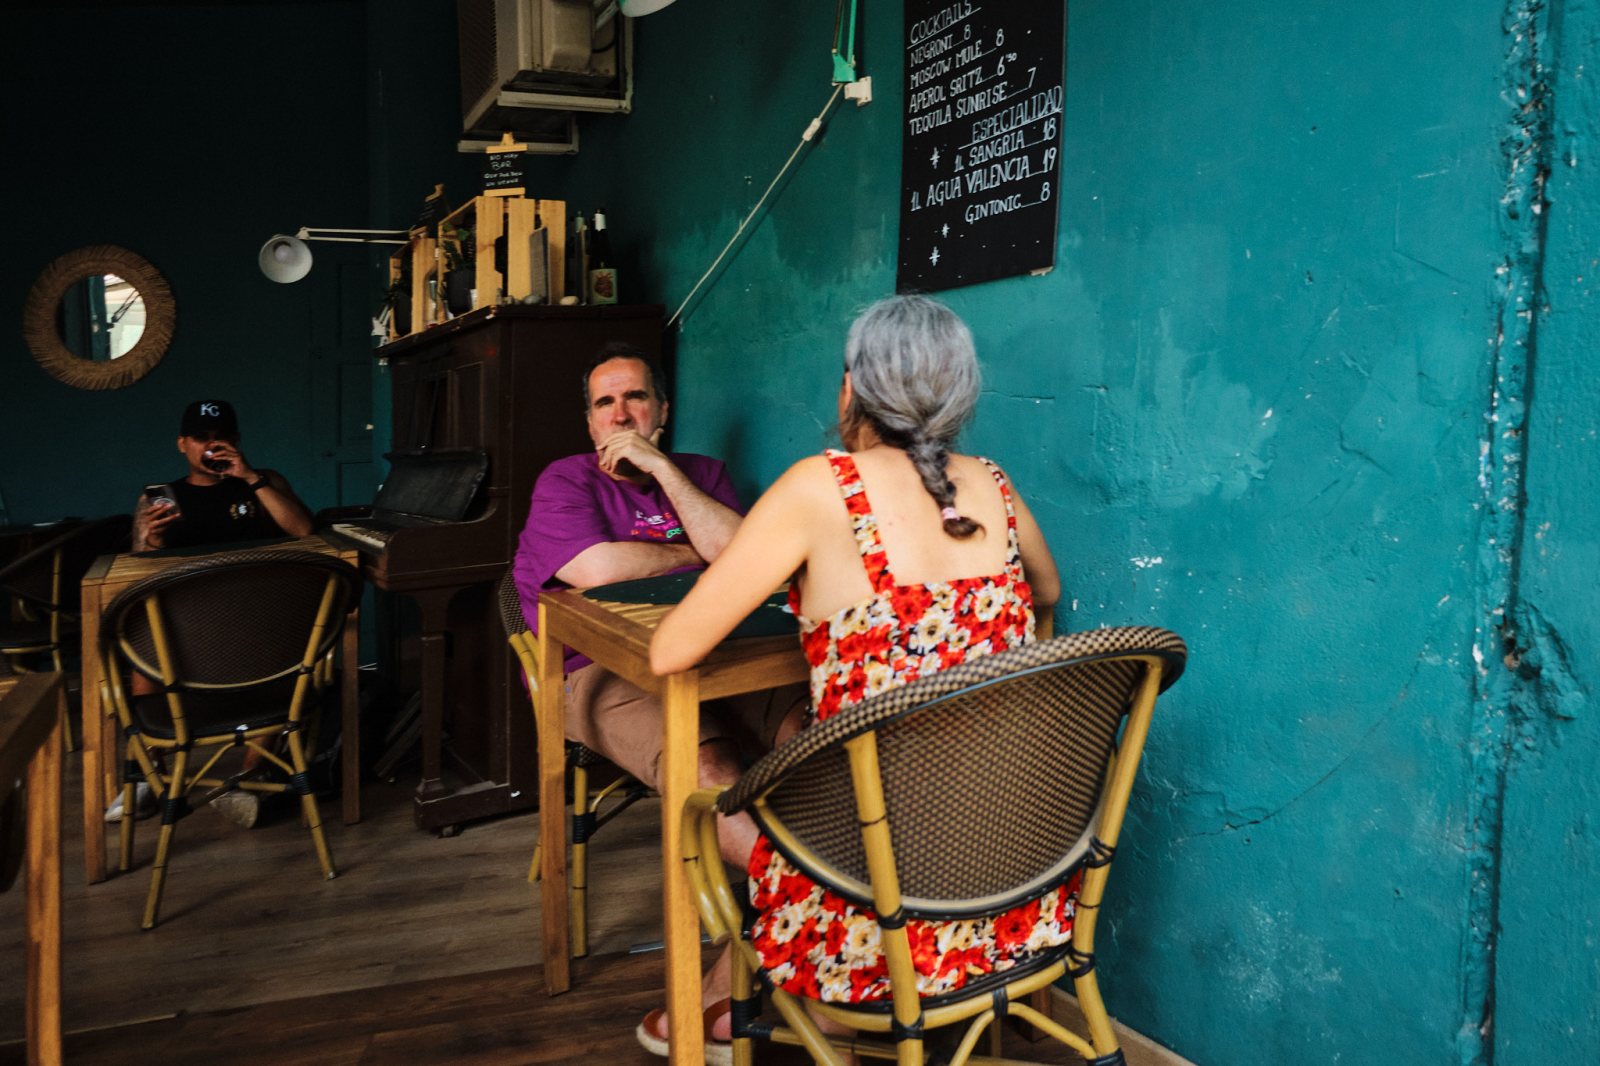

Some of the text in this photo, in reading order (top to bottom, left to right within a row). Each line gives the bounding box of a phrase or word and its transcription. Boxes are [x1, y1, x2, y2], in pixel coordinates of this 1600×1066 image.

[910, 0, 972, 44] COCKTAILS
[910, 24, 971, 67] NEGRONI 8
[910, 28, 1004, 90] MOSCOW MULE 8
[908, 86, 946, 114] APEROL
[909, 67, 1037, 136] TEQUILA SUNRISE 7
[972, 85, 1063, 144] ESPECIALIDAD
[969, 130, 1025, 166] SANGRIA
[1043, 117, 1056, 141] 18
[926, 176, 962, 207] AGUA
[965, 155, 1030, 193] VALENCIA
[1042, 147, 1057, 173] 19
[965, 182, 1050, 224] GINTONIC 8
[200, 403, 220, 417] KC
